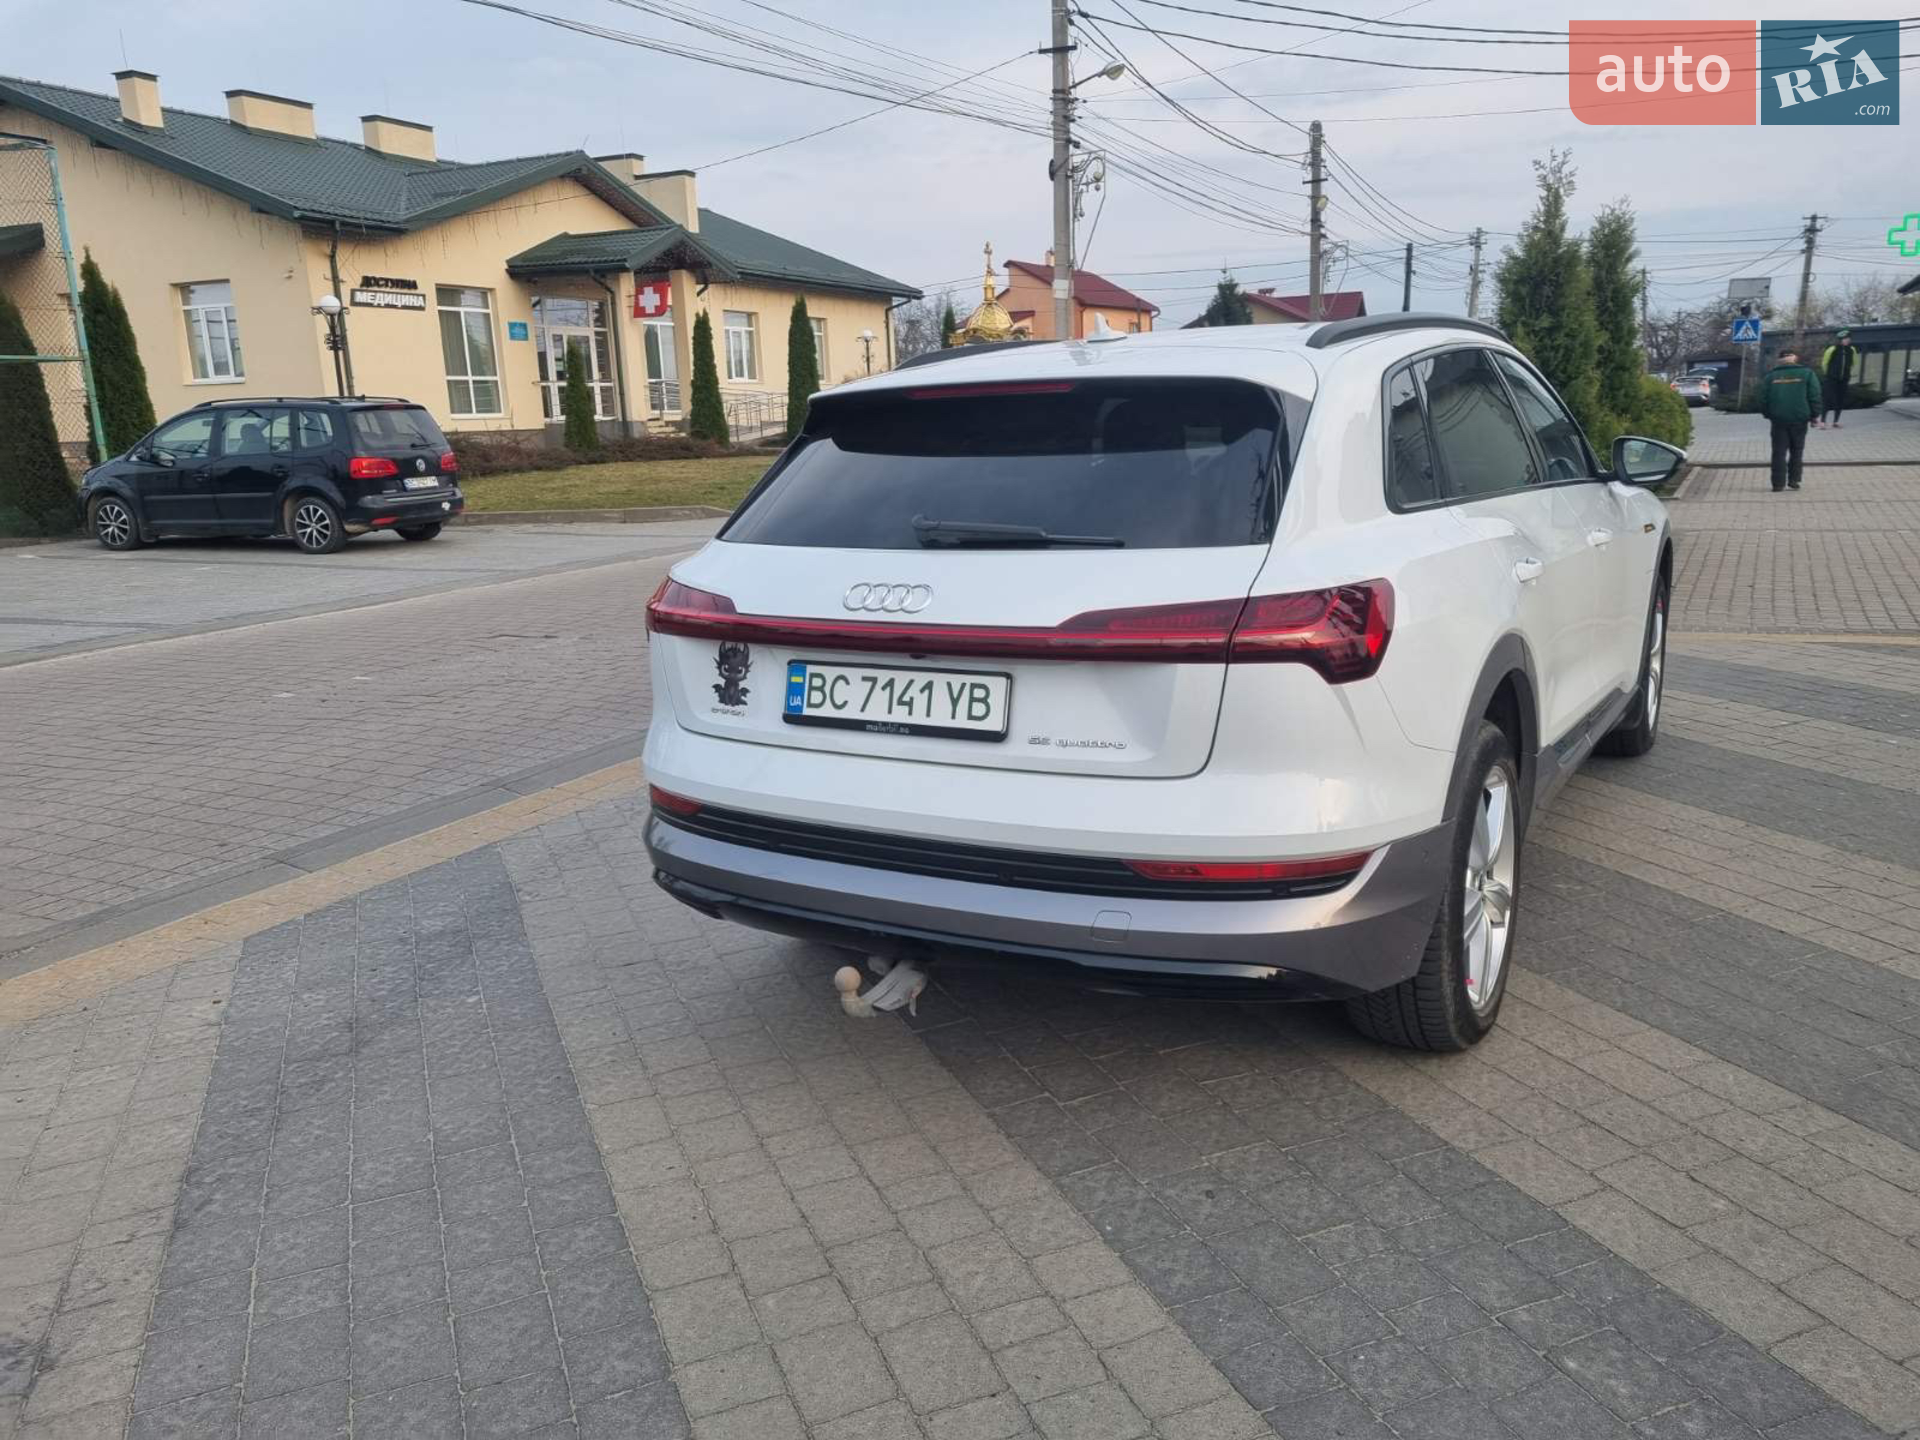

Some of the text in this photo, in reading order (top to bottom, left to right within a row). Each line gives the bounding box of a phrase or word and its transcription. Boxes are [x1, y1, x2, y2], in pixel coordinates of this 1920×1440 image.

[360, 275, 418, 290] ДОСТУПНА
[353, 290, 425, 307] МЕДИЦИНА
[788, 695, 803, 707] UA
[806, 672, 991, 722] BC 7141 YB
